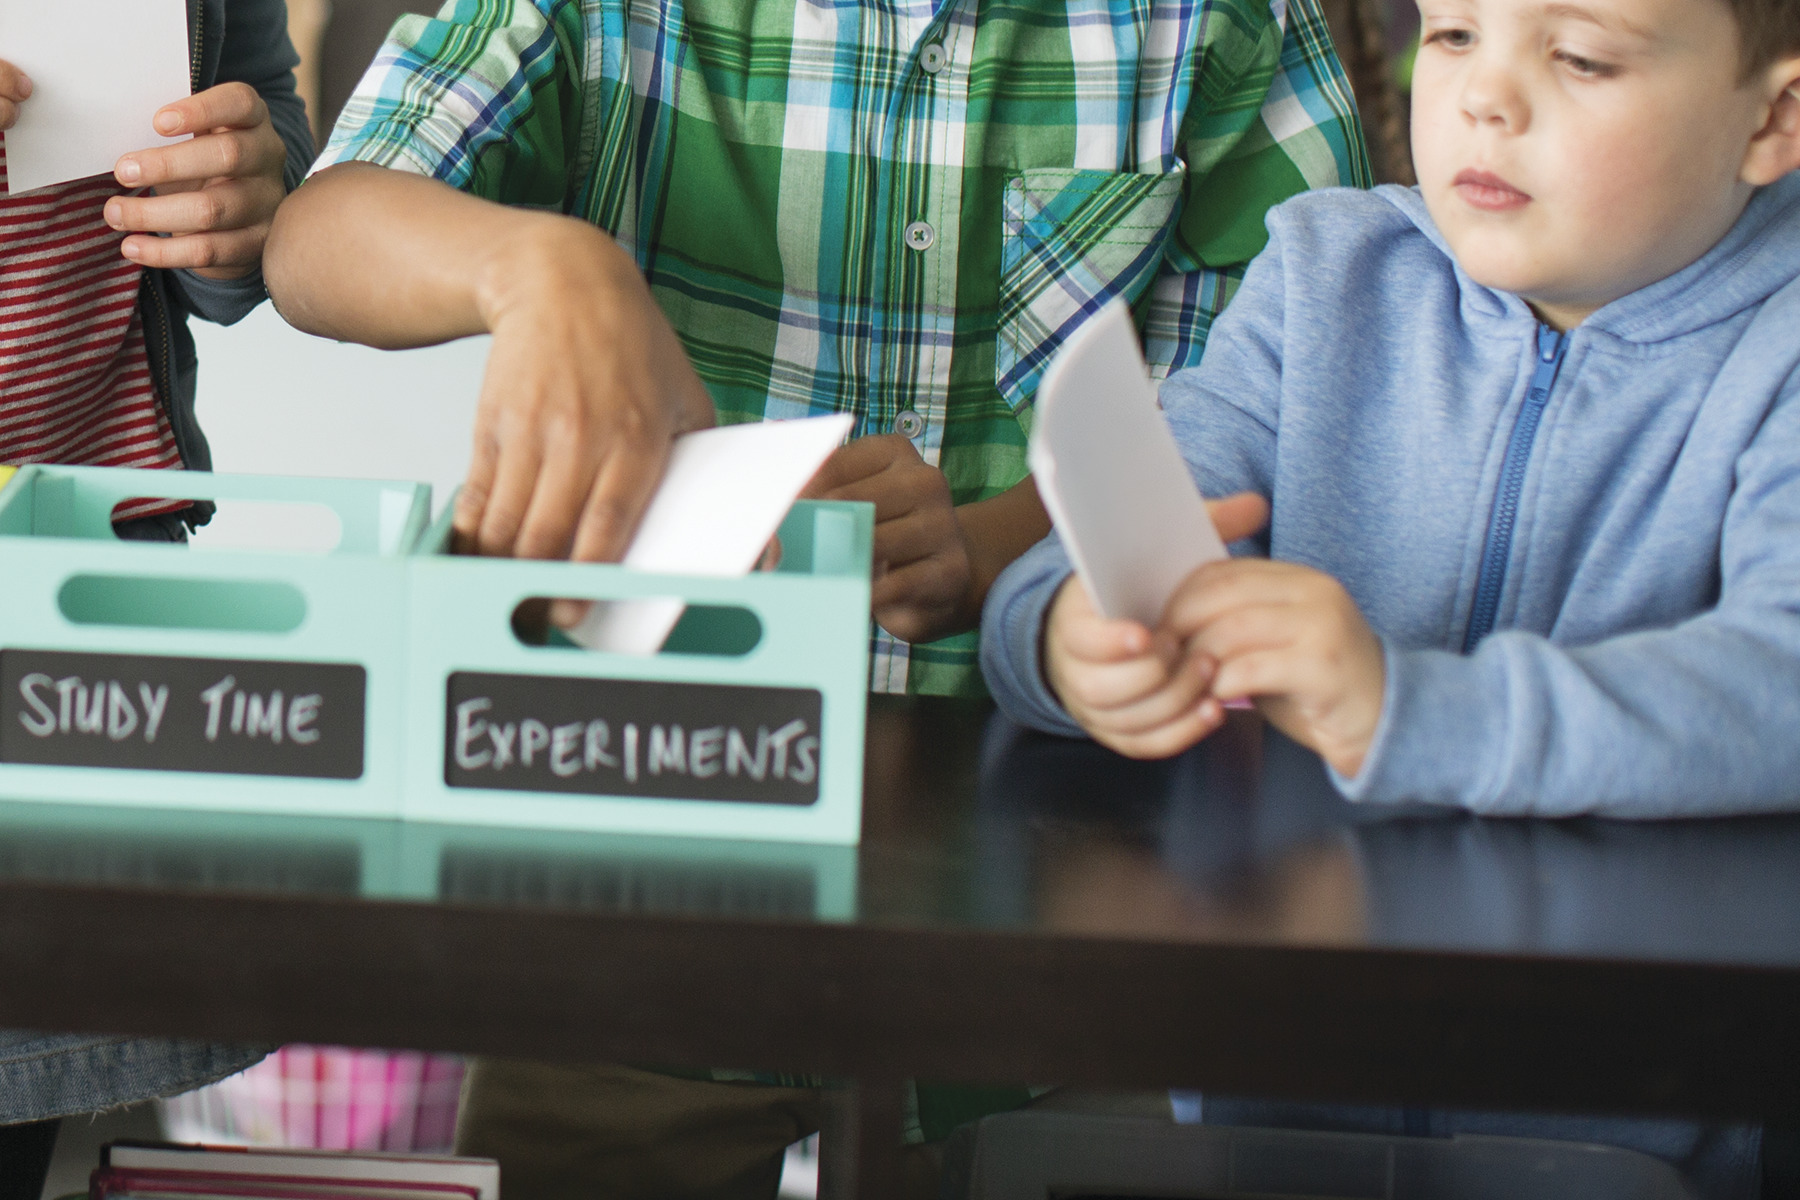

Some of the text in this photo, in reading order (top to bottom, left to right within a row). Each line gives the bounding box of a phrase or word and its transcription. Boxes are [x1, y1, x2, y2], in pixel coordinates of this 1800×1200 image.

[18, 673, 322, 744] STUDY TIME
[454, 696, 820, 784] EXPERIMENTS
